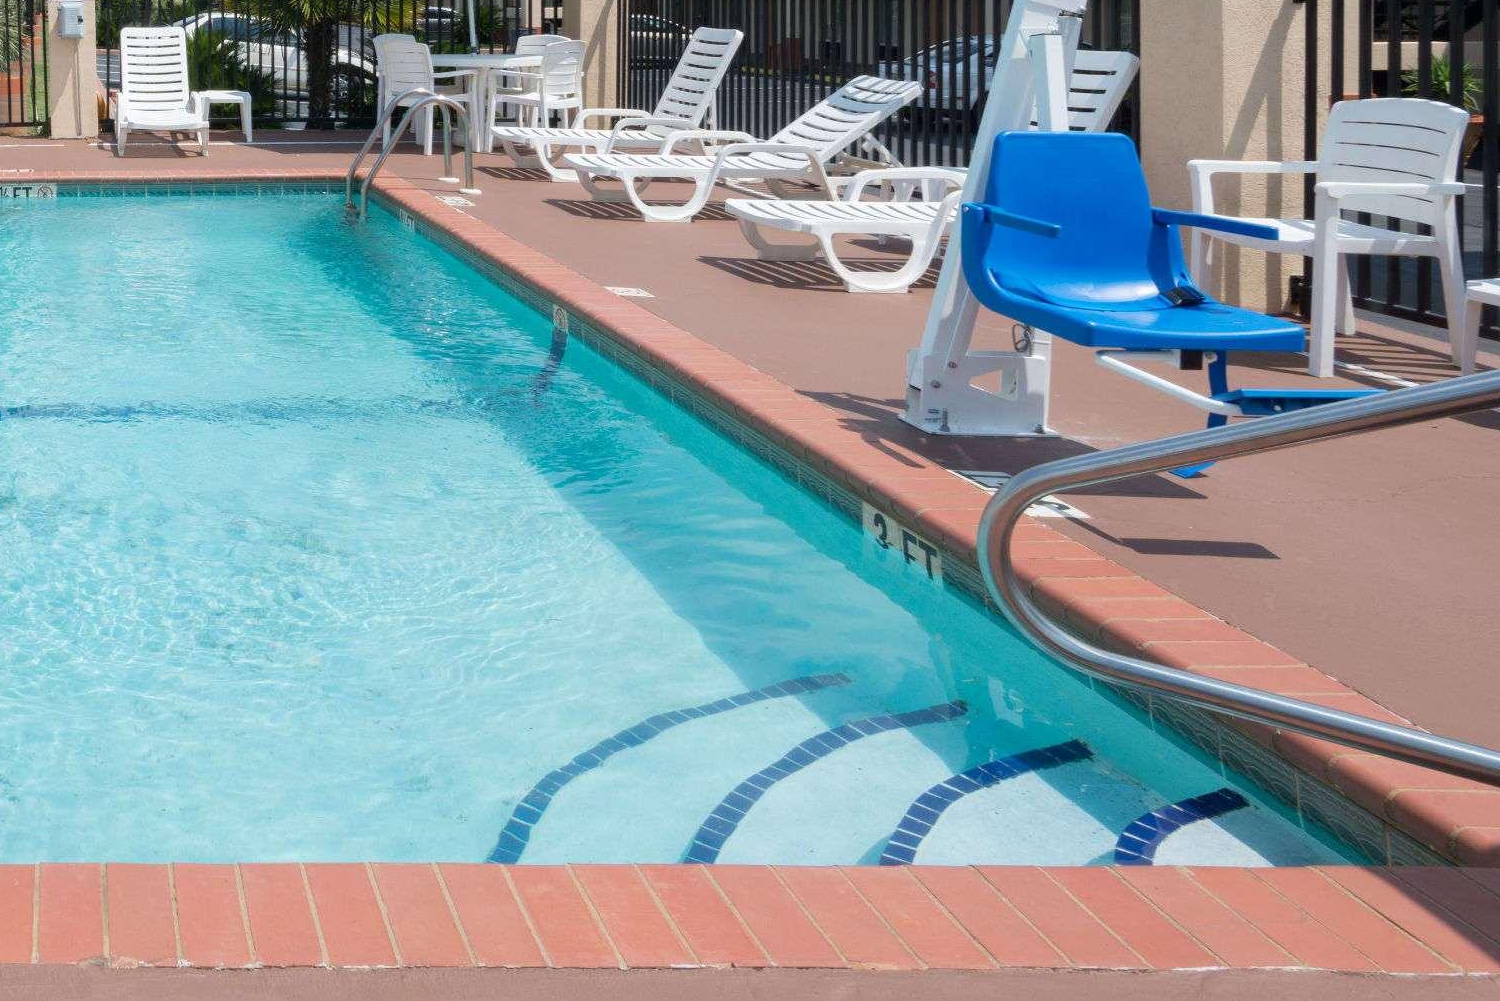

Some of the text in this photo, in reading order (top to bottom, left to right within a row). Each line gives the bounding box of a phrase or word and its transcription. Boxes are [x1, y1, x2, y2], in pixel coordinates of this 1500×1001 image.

[13, 186, 33, 198] FT
[873, 512, 938, 581] 3 FT
